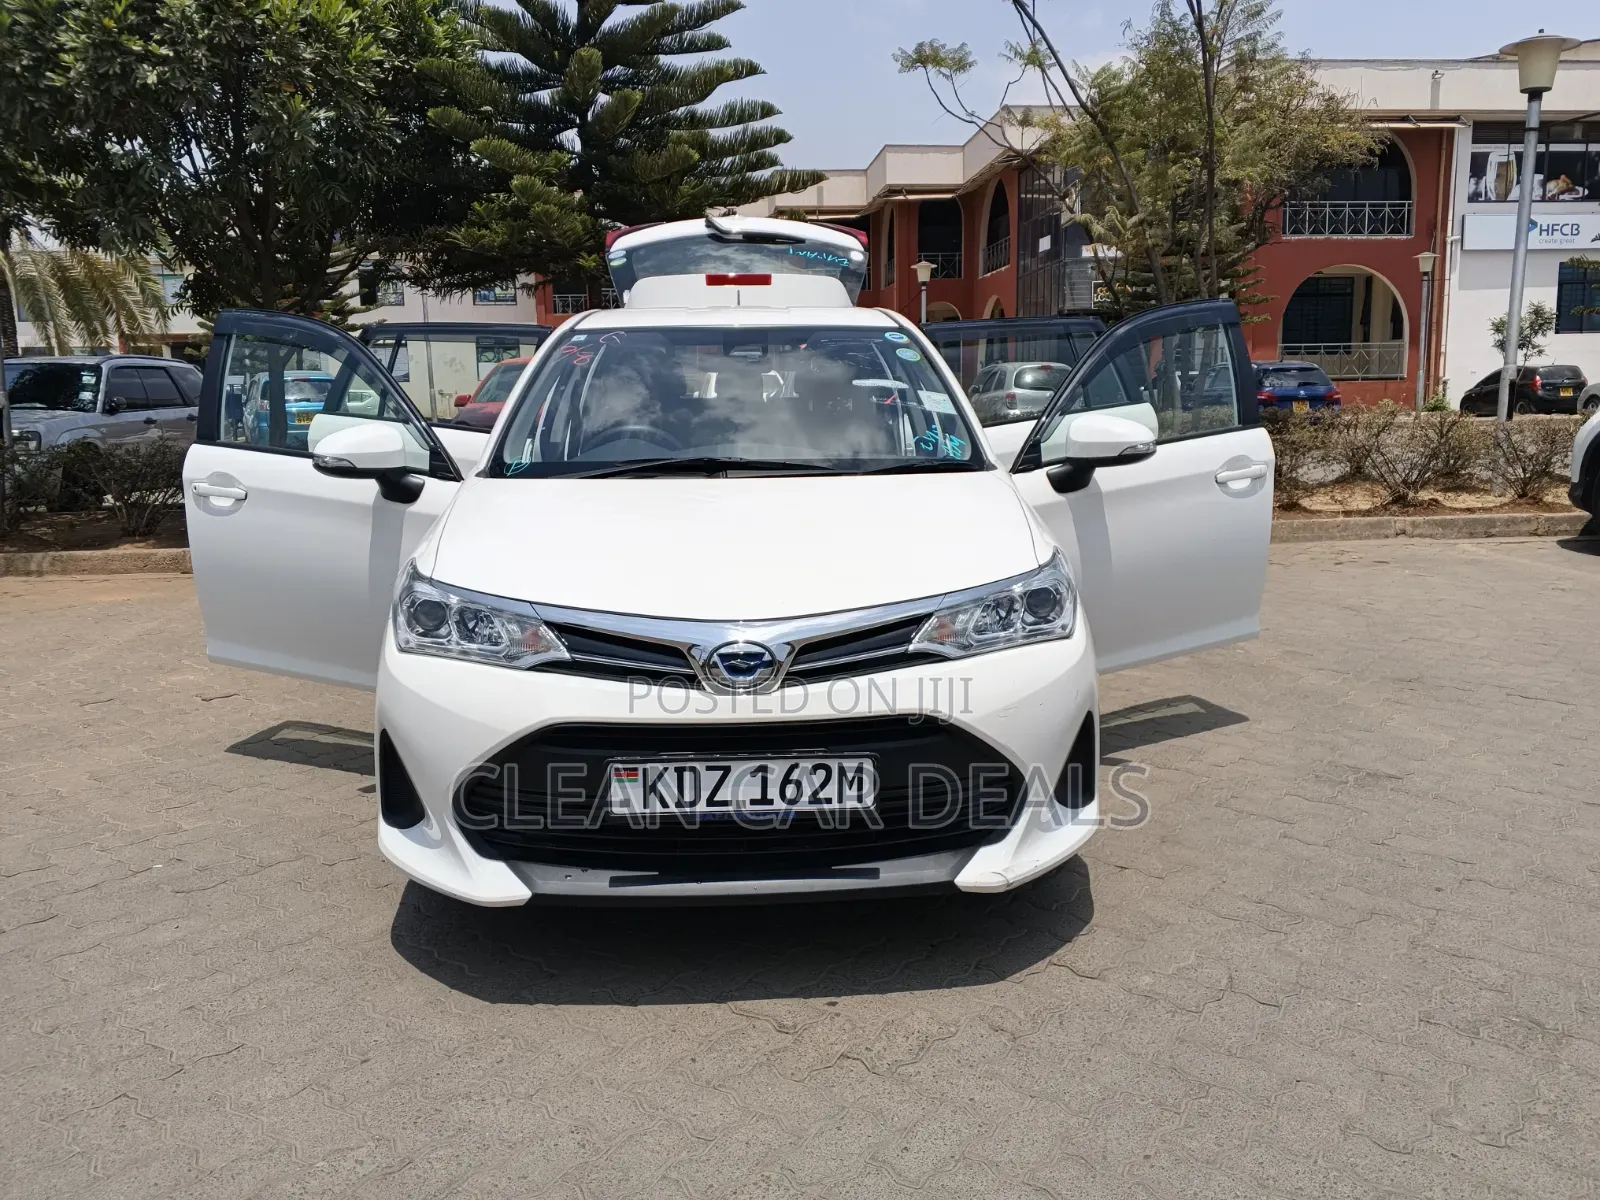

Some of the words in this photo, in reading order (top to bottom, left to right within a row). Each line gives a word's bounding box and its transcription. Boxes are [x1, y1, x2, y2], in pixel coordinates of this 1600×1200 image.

[1539, 223, 1580, 236] HFCB
[1559, 238, 1576, 246] great
[640, 765, 733, 810] KDZ
[748, 761, 865, 807] 162M
